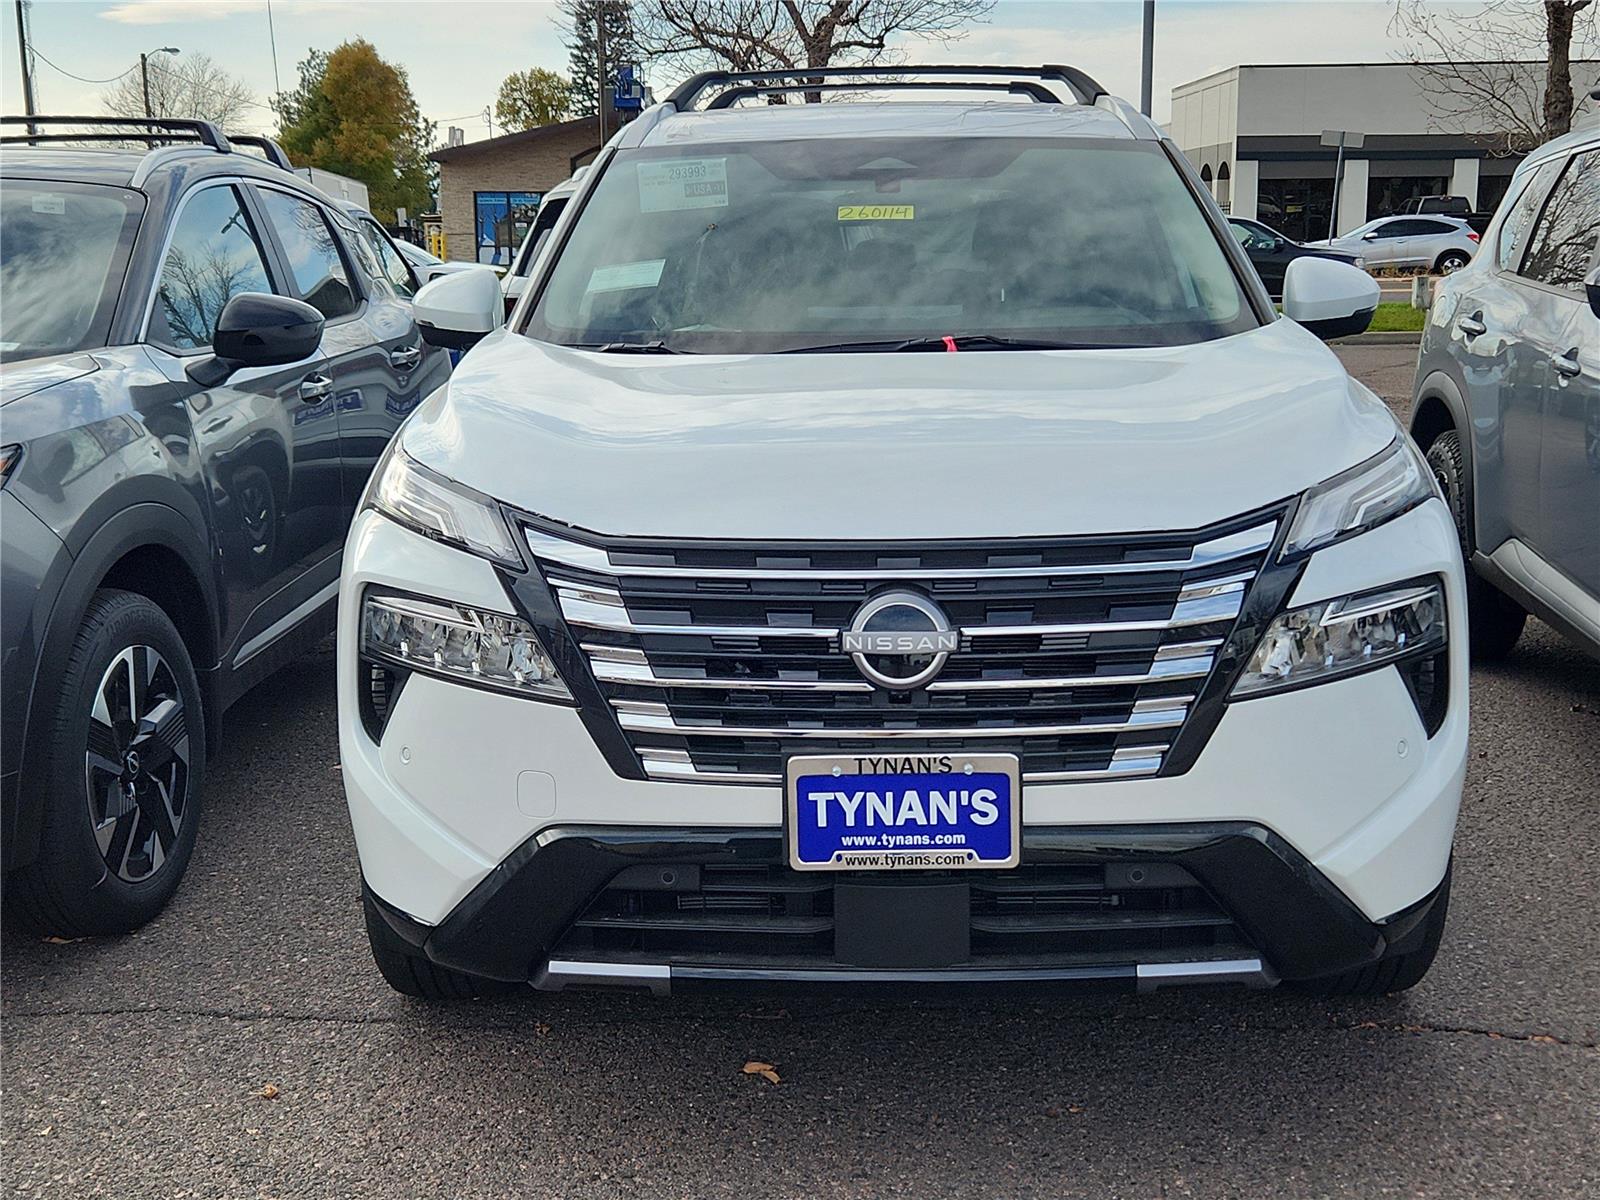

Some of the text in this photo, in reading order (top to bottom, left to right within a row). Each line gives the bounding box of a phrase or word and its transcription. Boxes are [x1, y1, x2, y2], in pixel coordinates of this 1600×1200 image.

[669, 165, 706, 179] 293993
[839, 206, 911, 219] 260114
[846, 636, 955, 651] NISSAN
[854, 756, 952, 776] TYNAN'S
[808, 788, 999, 828] TYNAN'S
[841, 833, 966, 848] www.tynans.com
[844, 852, 965, 869] www.tynans.com
